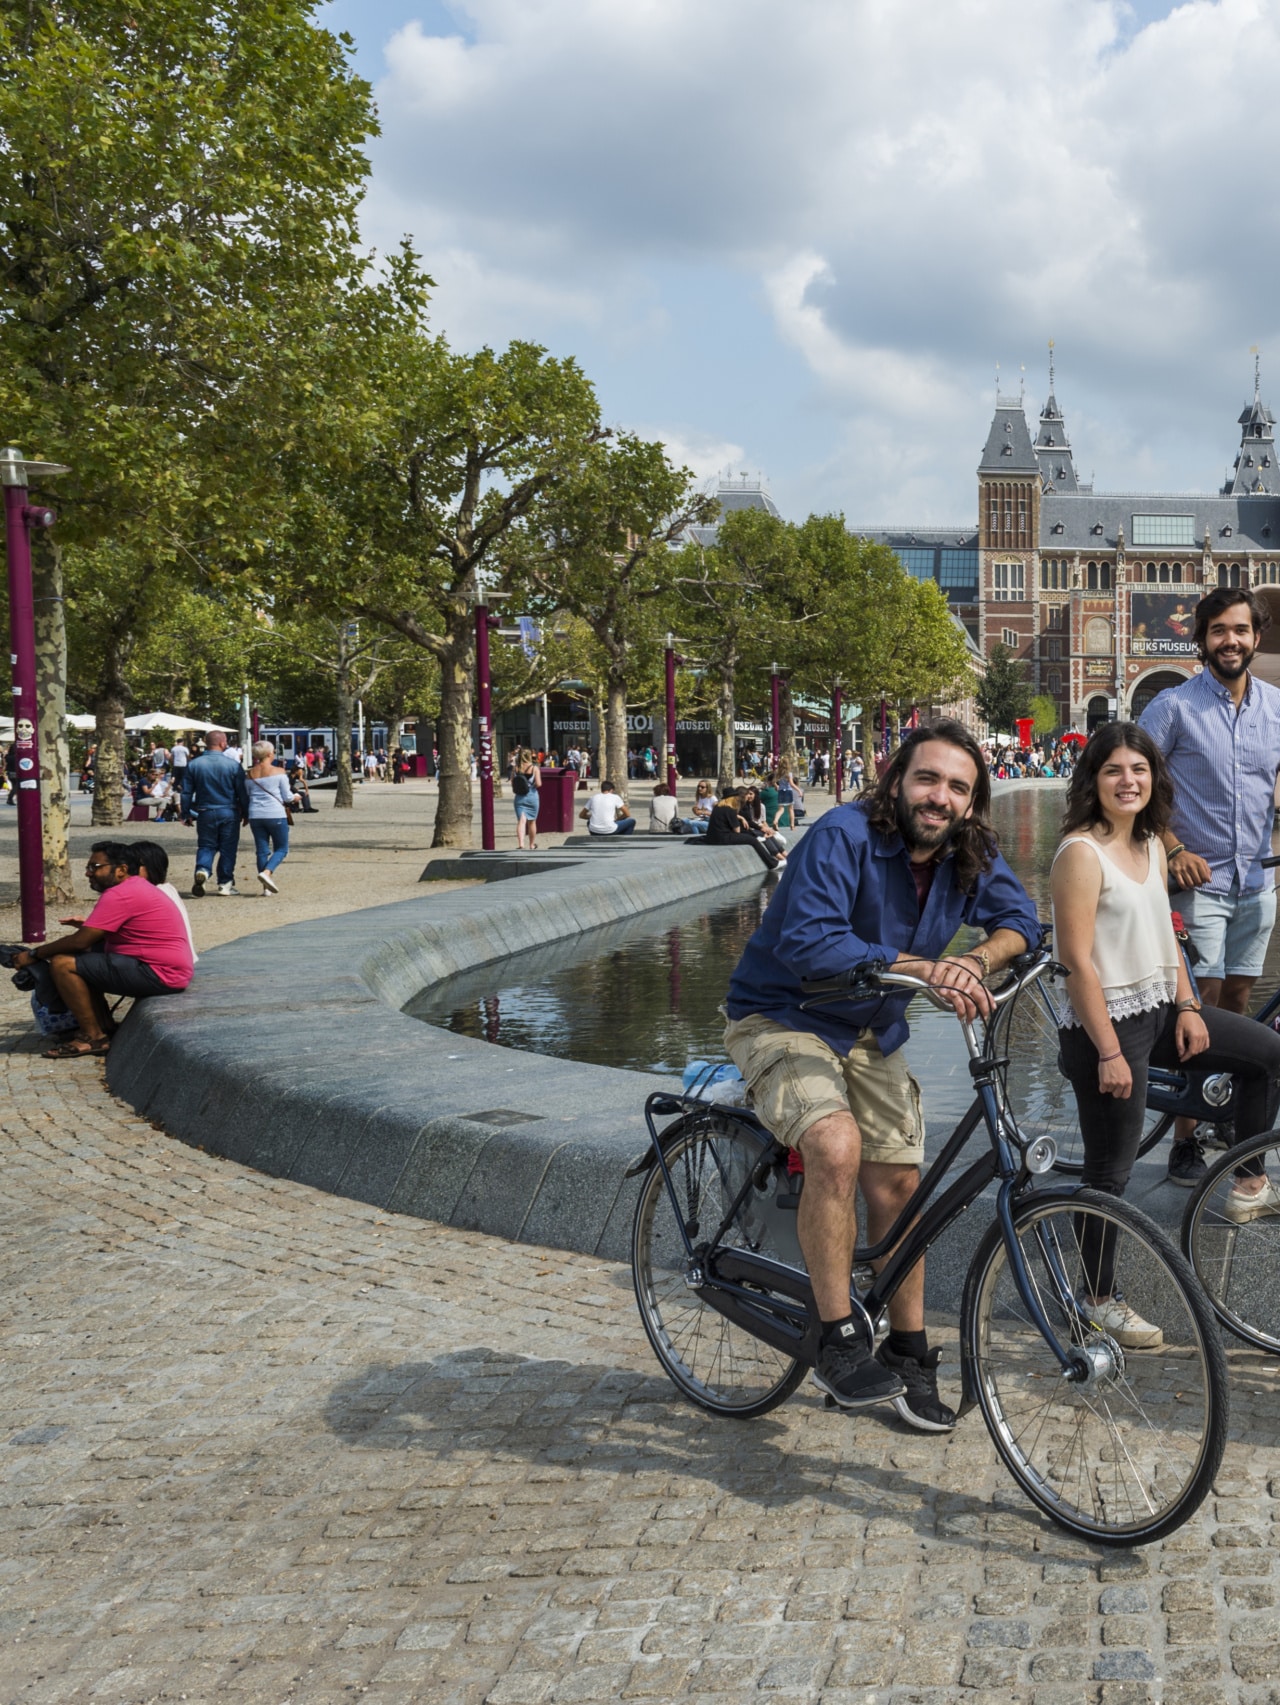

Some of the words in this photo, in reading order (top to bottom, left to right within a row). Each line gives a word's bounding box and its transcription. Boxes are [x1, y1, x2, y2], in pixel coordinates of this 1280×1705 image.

[1159, 642, 1198, 652] MUSEUM
[675, 720, 713, 731] MUSEU
[734, 721, 763, 731] USEUM
[804, 722, 830, 733] MUSEU
